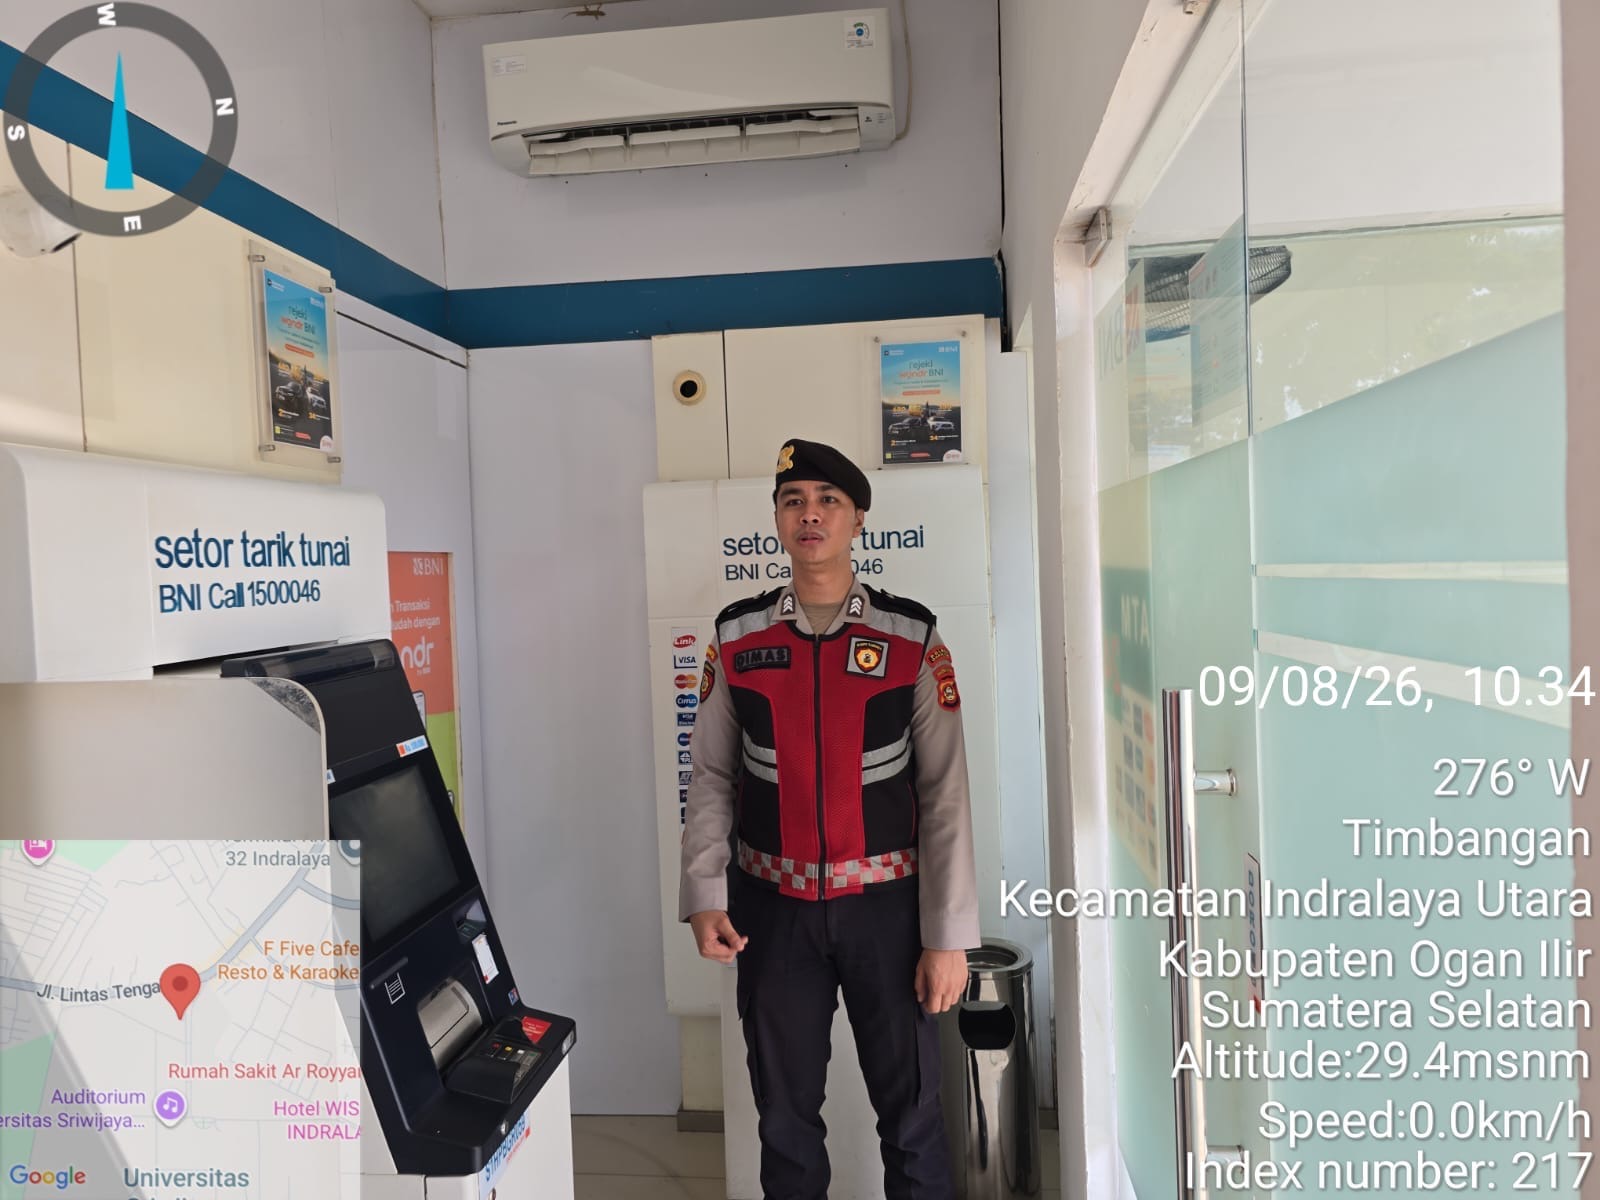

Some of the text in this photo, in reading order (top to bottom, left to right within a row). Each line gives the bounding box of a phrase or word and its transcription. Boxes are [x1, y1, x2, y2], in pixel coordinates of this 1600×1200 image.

[861, 525, 924, 551] tunai
[155, 528, 350, 569] setor tarik tunai
[424, 558, 444, 576] BNI
[725, 564, 759, 581] BNI
[766, 563, 792, 579] Ca
[159, 579, 321, 613] BNI Call 1500046
[413, 616, 441, 630] dengan
[678, 656, 697, 664] VISA
[736, 648, 786, 667] DIMAS
